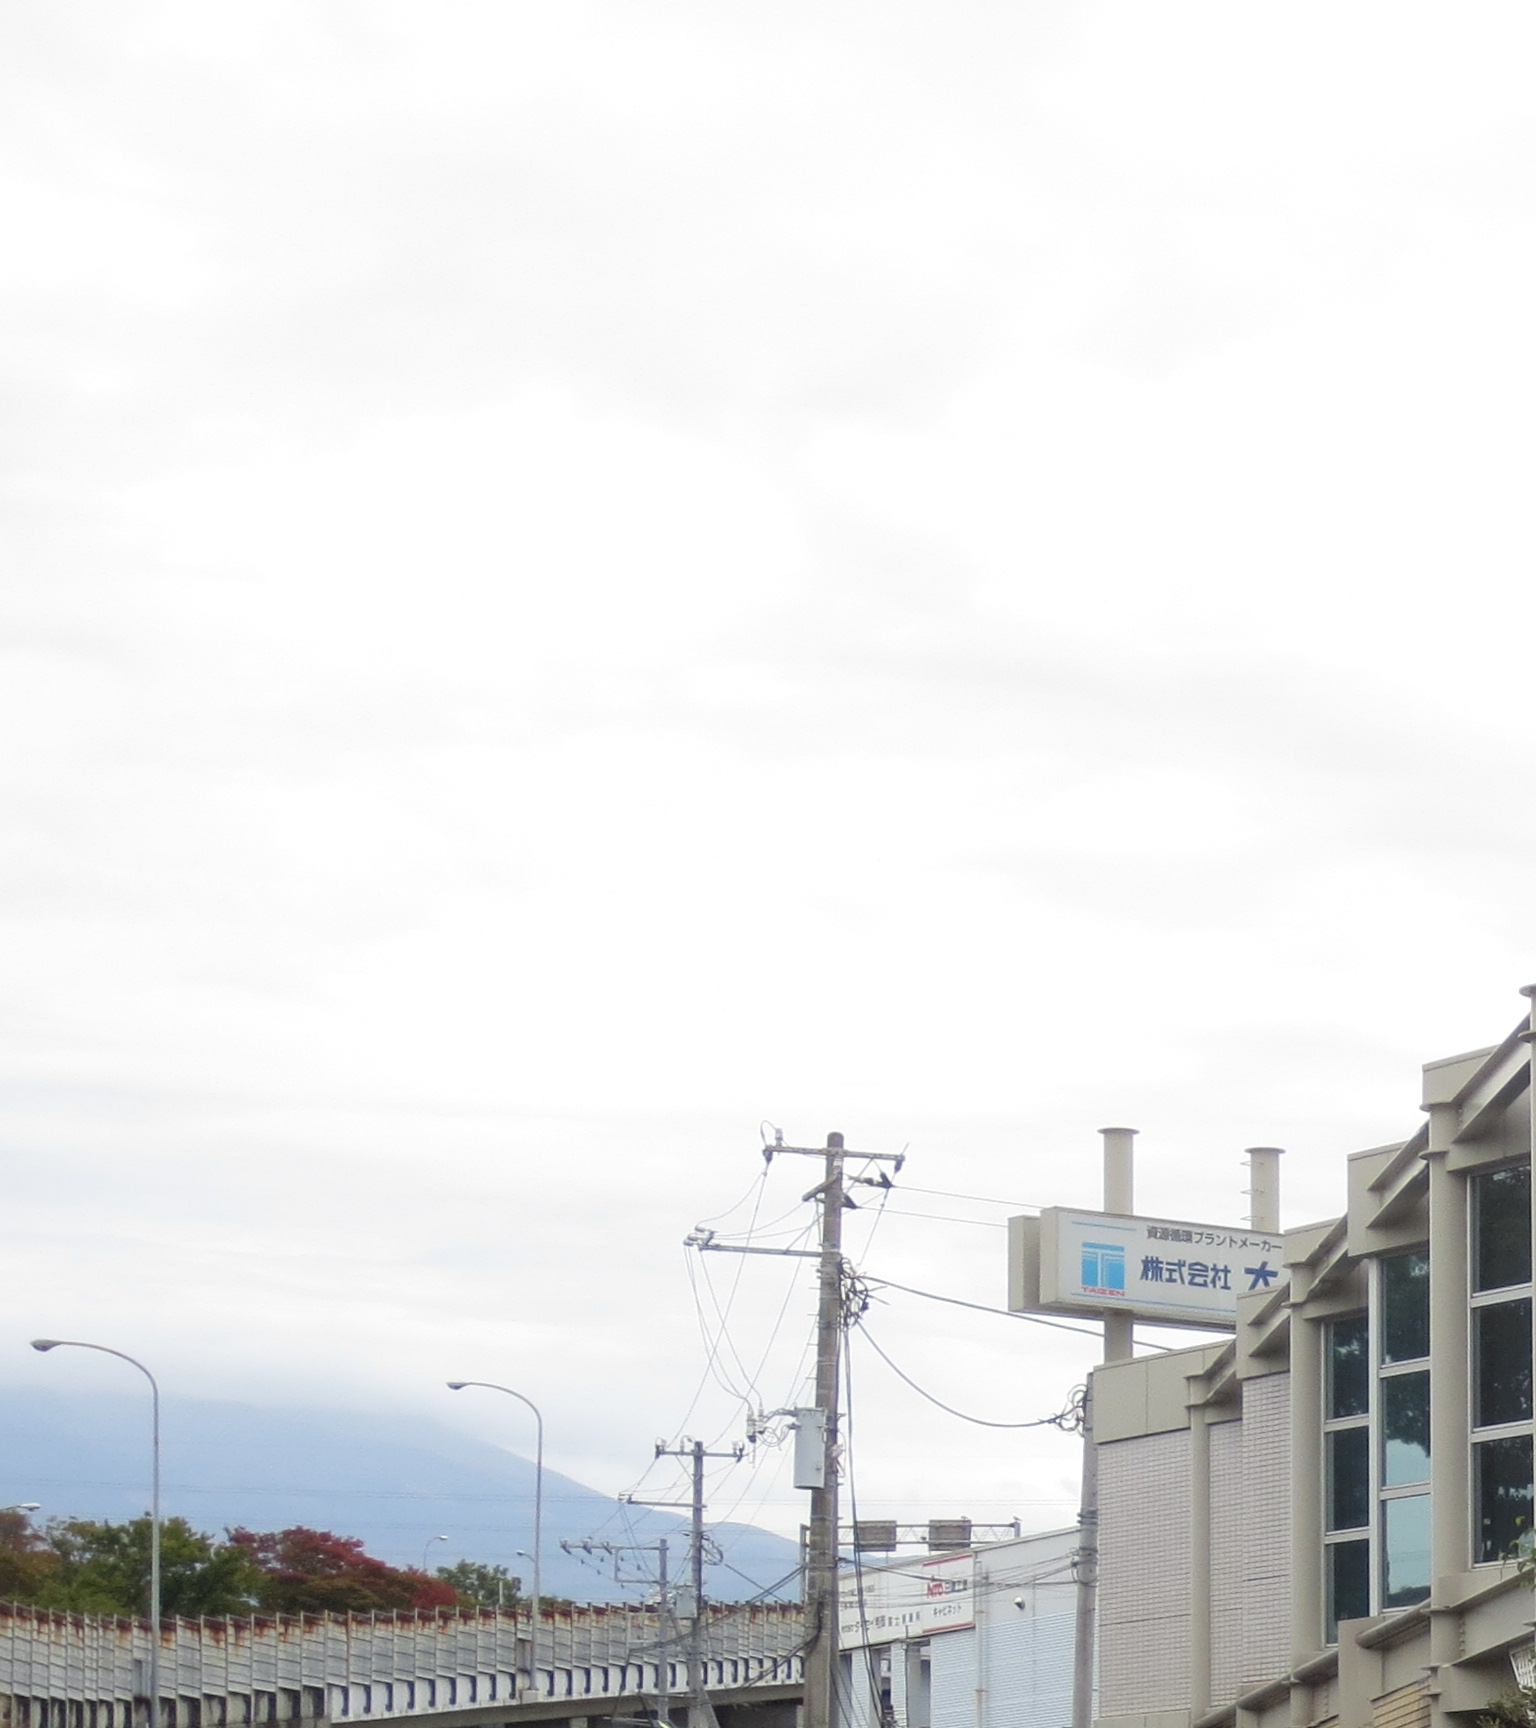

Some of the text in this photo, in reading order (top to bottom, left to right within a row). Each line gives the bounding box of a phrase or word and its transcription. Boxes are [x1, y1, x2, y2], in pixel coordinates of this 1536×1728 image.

[1146, 1225, 1282, 1252] 資源循環プラントメーカー
[1139, 1255, 1278, 1291] 株式会社 大
